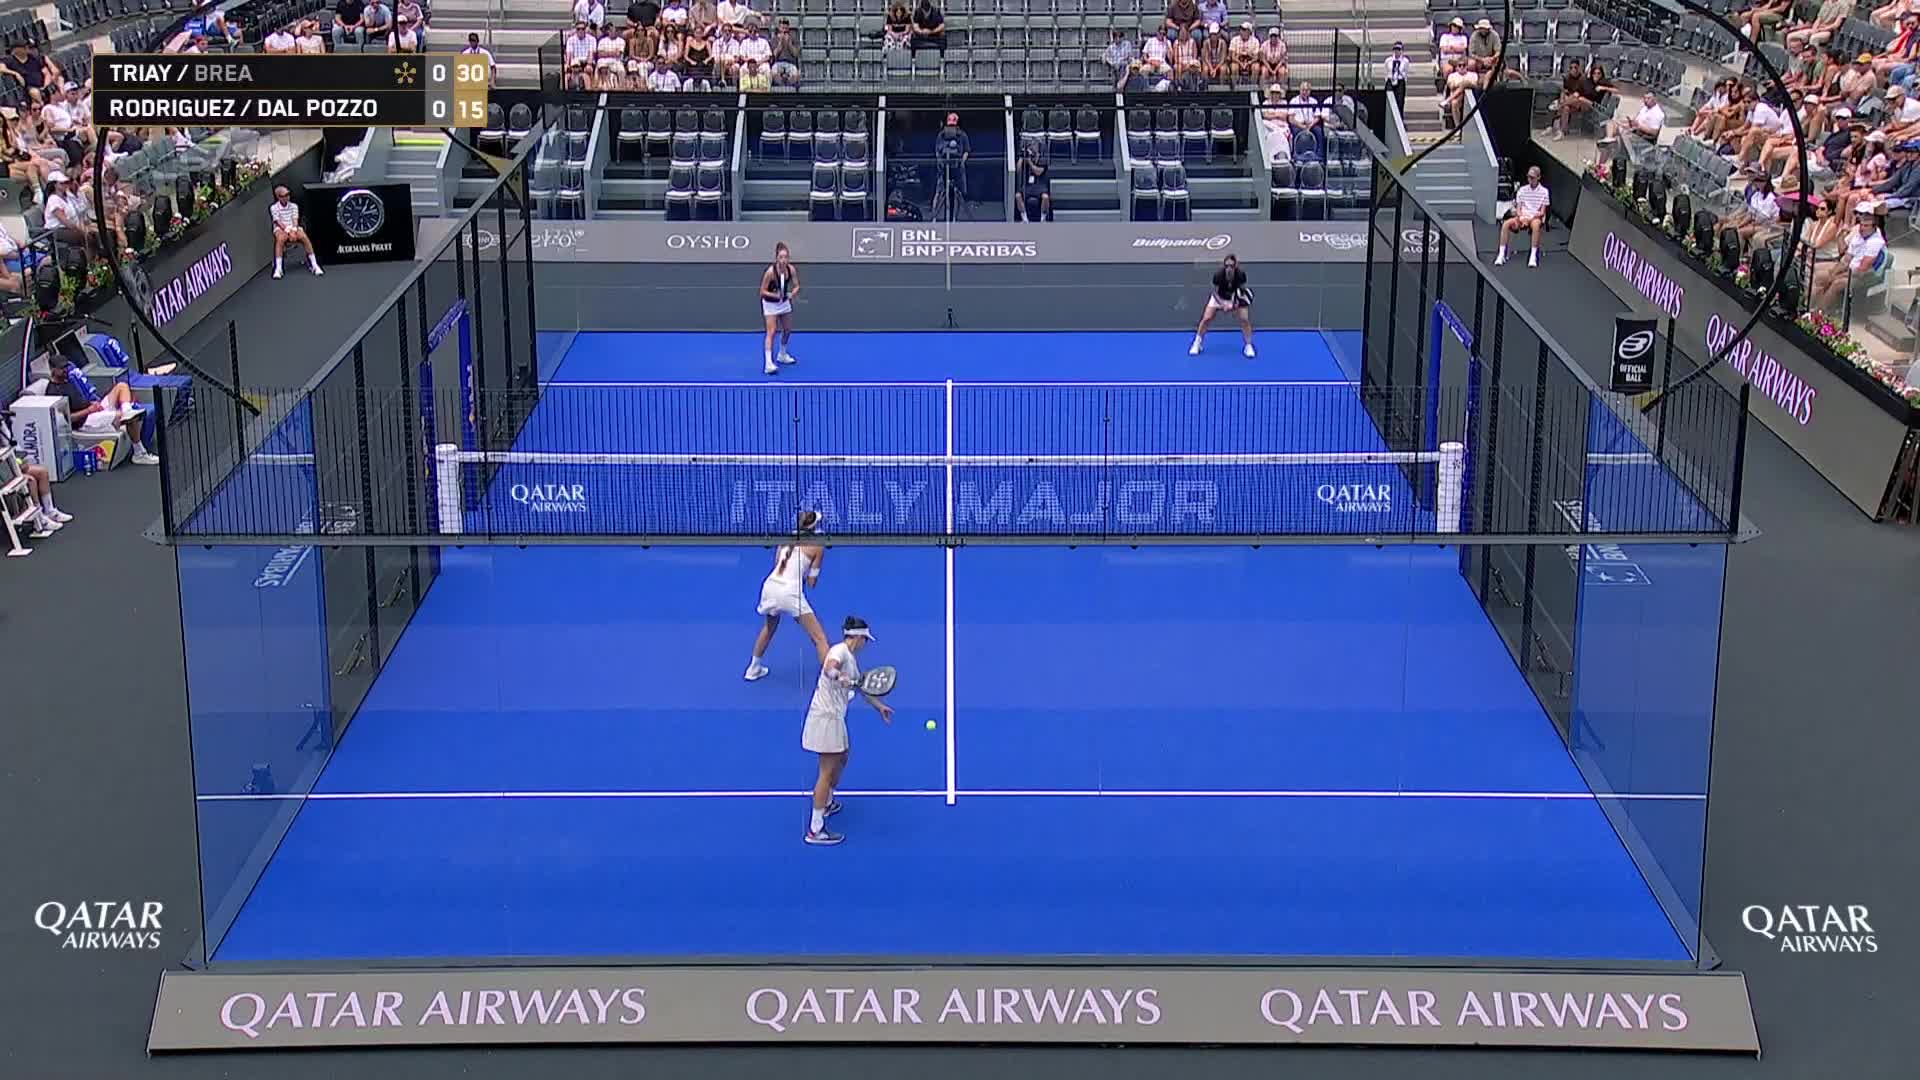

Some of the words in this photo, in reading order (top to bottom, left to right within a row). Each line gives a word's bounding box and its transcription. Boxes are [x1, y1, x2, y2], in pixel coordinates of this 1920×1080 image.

[667, 235, 749, 249] OYSHO
[902, 230, 942, 241] BNL
[902, 246, 944, 257] BNP
[950, 246, 1037, 257] PARIBAS
[152, 282, 185, 329] ATAR
[185, 242, 232, 306] AIRWAYS
[1603, 232, 1636, 283] QATAR
[1634, 261, 1684, 319] AIRWAYS
[1619, 364, 1647, 373] OFFICIAL
[1625, 373, 1642, 382] BALL
[1749, 350, 1816, 424] AIRWAYS
[511, 484, 585, 504] QATAR
[727, 481, 929, 524] ITALY
[958, 480, 1219, 525] MAJOR
[1317, 484, 1391, 504] QATAR
[532, 502, 587, 512] AIRWAYS
[1335, 502, 1391, 512] AIRWAYS
[34, 901, 163, 936] QATAR
[1742, 904, 1875, 939] QATAR
[62, 931, 161, 949] AIRWAYS
[1780, 935, 1878, 953] AIRWAYS
[219, 991, 404, 1039] QATAR
[417, 988, 648, 1026] AIRWAYS
[745, 987, 923, 1032] QATAR
[937, 987, 1162, 1025] AIRWAYS
[1260, 988, 1442, 1034] QATAR
[1456, 990, 1689, 1031] AIRWAYS
